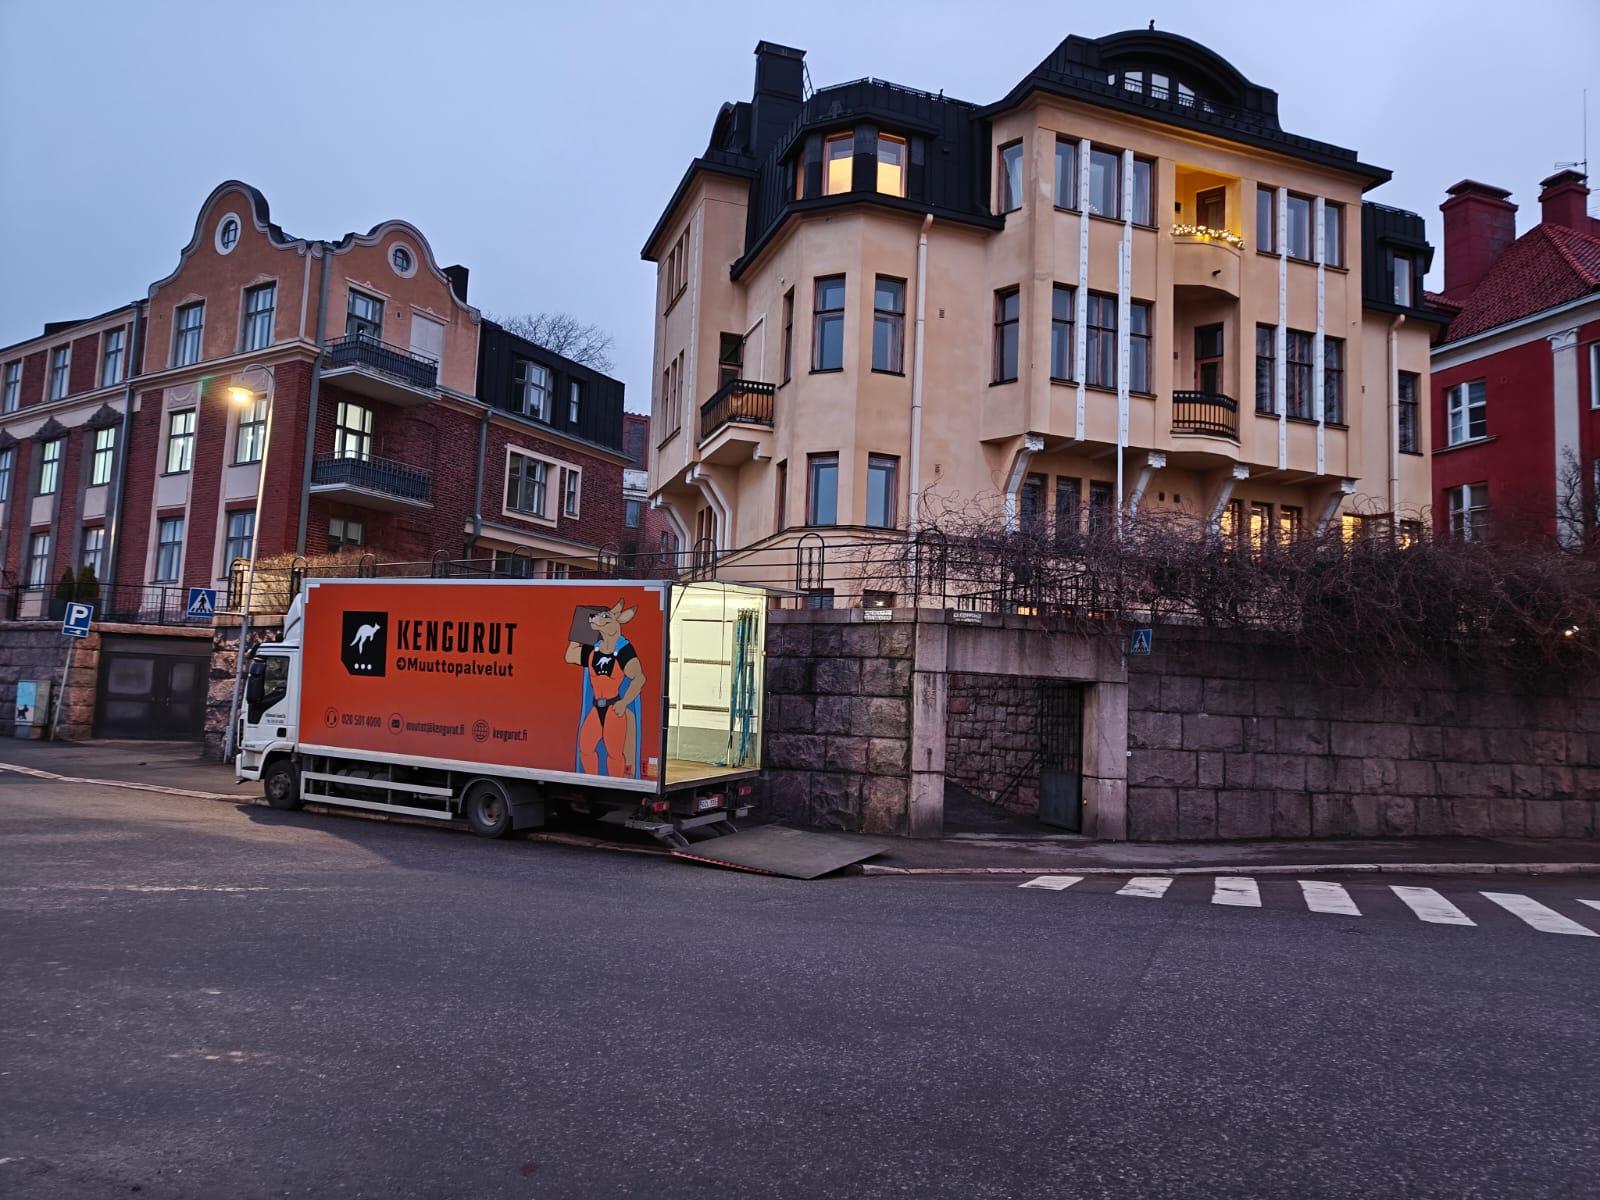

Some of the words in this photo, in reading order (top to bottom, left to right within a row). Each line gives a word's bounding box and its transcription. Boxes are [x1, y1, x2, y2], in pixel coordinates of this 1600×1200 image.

[69, 605, 89, 626] P
[397, 619, 518, 655] KENGURUT
[407, 657, 514, 677] Muuttopalvelut
[493, 728, 528, 742] kengurut.fi
